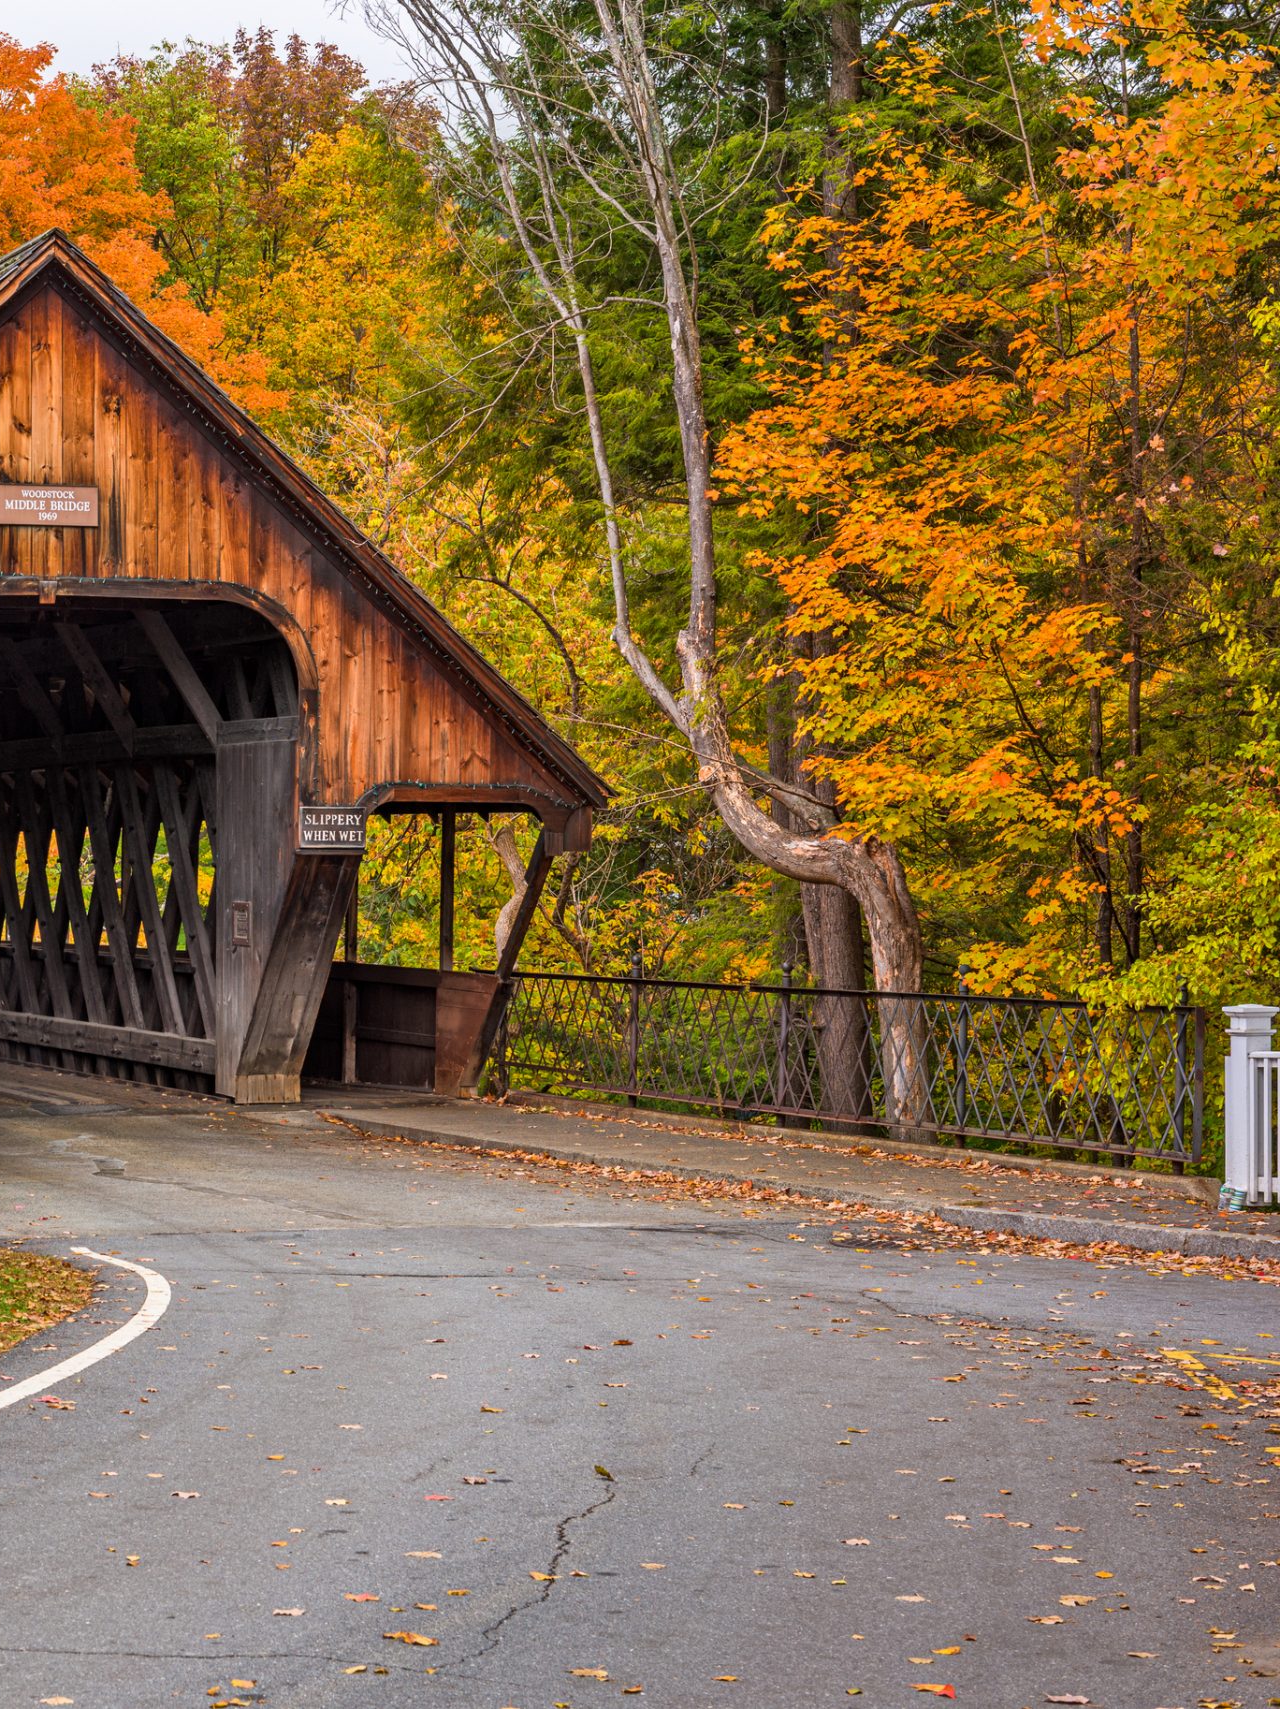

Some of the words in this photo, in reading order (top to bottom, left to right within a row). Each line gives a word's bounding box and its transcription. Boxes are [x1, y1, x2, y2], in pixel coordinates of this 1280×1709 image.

[21, 489, 75, 499] WOODSTOCK
[5, 500, 46, 510] MIDDLE
[50, 501, 91, 512] BRIDGE
[38, 512, 58, 521] 1969
[304, 814, 362, 826] SLIPPERY
[303, 830, 336, 842] WHEN
[339, 830, 364, 842] WET
